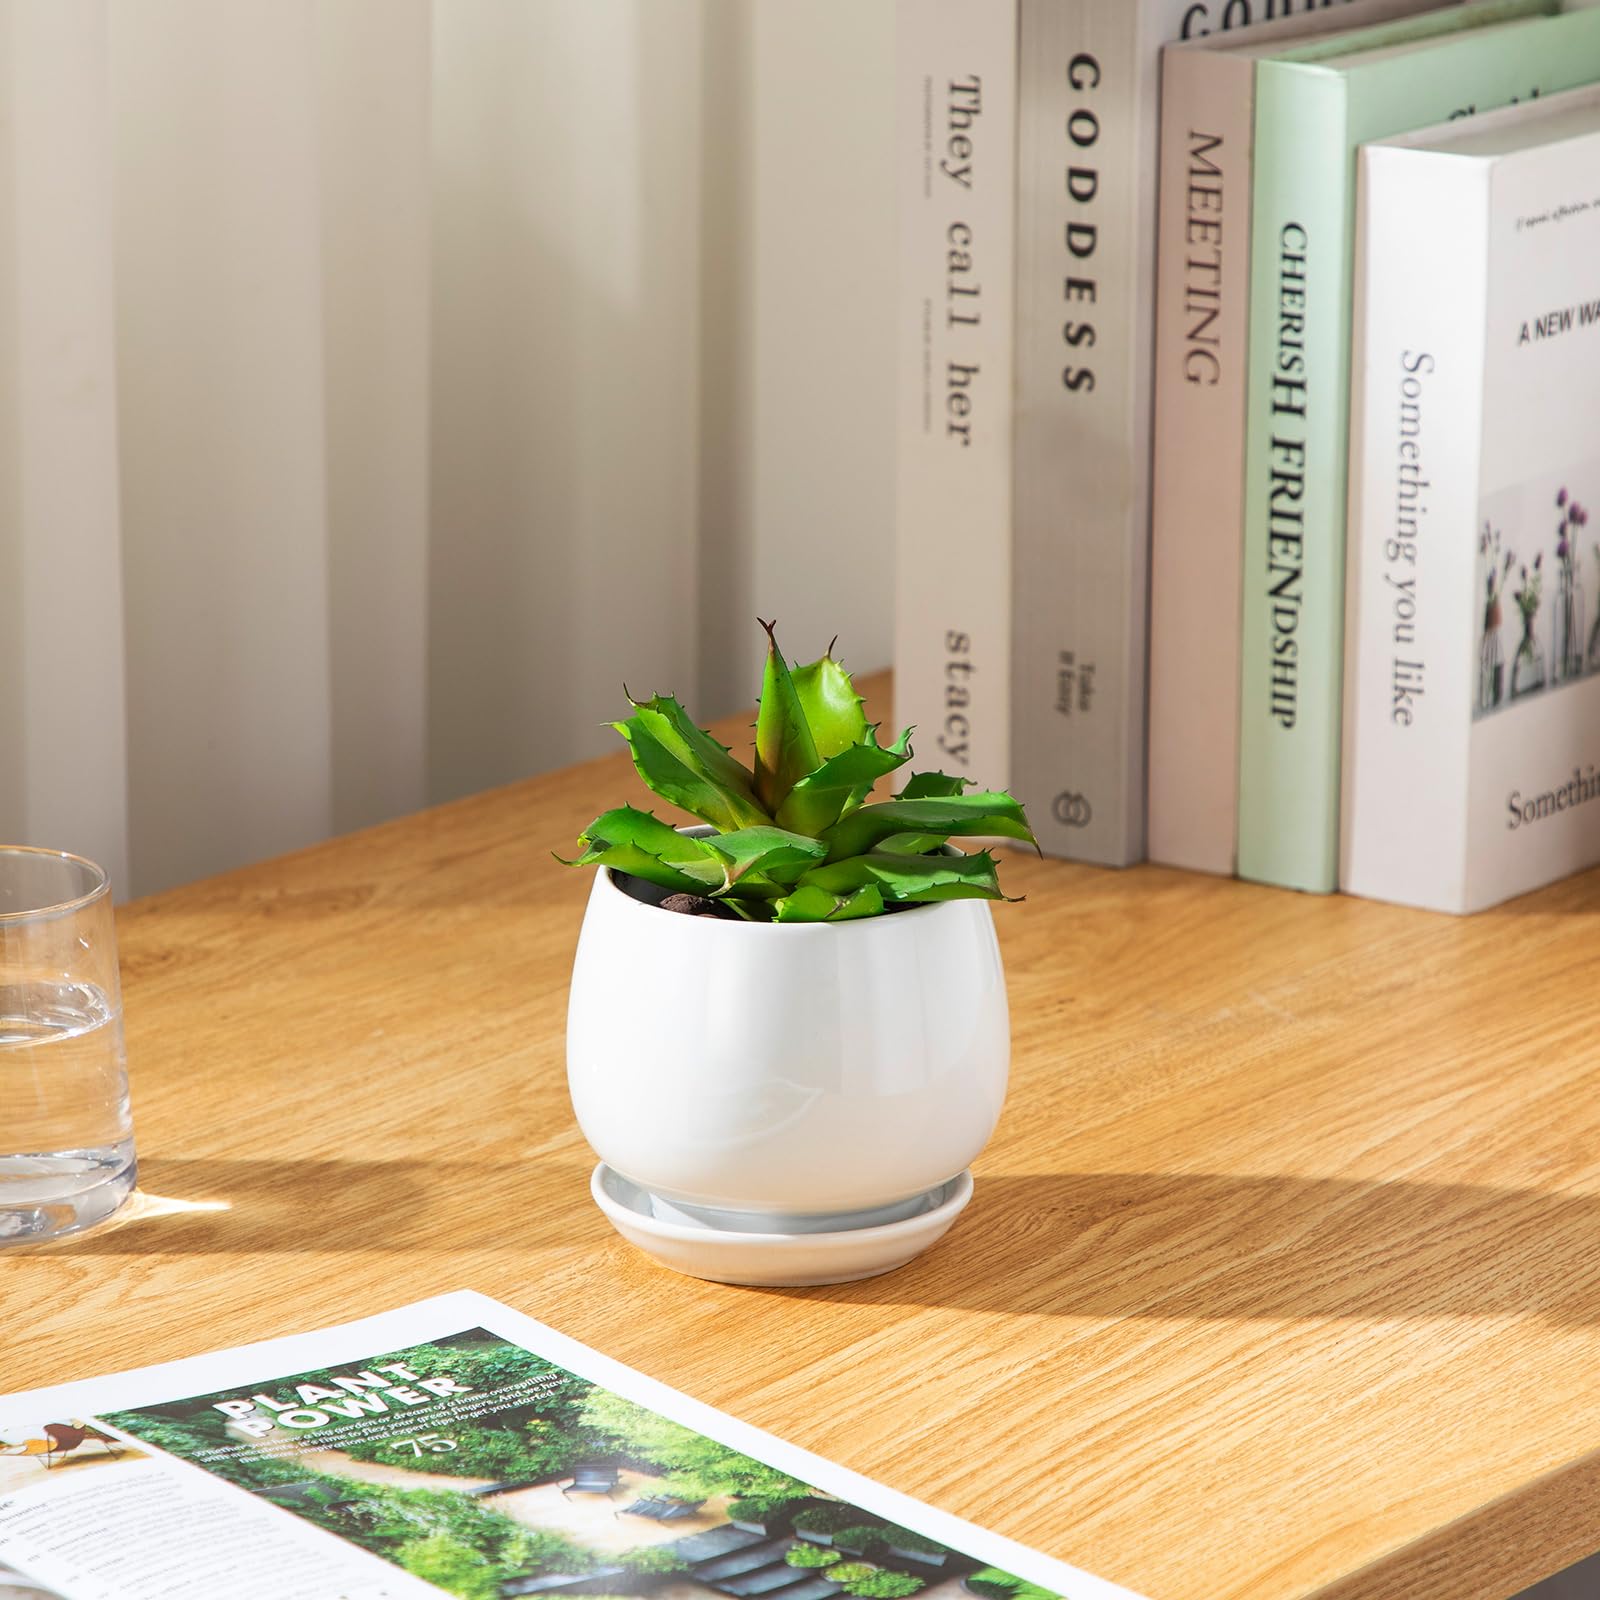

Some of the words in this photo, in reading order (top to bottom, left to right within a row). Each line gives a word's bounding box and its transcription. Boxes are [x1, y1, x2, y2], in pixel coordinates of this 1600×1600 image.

[940, 75, 981, 190] They
[1062, 53, 1101, 395] GODDESS
[1183, 129, 1224, 386] MEETING
[947, 222, 981, 329] call
[1271, 221, 1308, 419] CHERISH
[1517, 320, 1530, 347] A
[1535, 306, 1575, 341] NEW
[946, 363, 980, 447] her
[1385, 349, 1435, 566] Something
[1267, 434, 1306, 731] FRIENDSHIP
[1383, 573, 1418, 645] you
[937, 629, 978, 766] stacy
[1391, 658, 1426, 728] like
[1507, 764, 1600, 830] Somethi
[212, 1361, 420, 1421] PLANT
[228, 1377, 474, 1439] POWER
[299, 1438, 367, 1455] inspiration
[367, 1431, 391, 1441] and
[391, 1422, 432, 1436] expert
[431, 1417, 455, 1427] tips
[455, 1413, 469, 1421] to
[469, 1408, 490, 1419] get
[489, 1402, 513, 1414] you
[513, 1390, 555, 1406] started
[312, 1428, 334, 1438] big
[335, 1420, 379, 1435] garden
[378, 1416, 391, 1424] or
[393, 1407, 433, 1420] dream
[433, 1402, 447, 1411] of
[456, 1393, 489, 1405] home
[490, 1373, 558, 1396] overspilling
[319, 1433, 348, 1444] time
[362, 1425, 387, 1437] flex
[387, 1418, 414, 1431] your
[416, 1410, 452, 1423] green
[451, 1400, 498, 1416] fingers.
[499, 1390, 522, 1402] And
[523, 1385, 542, 1395] we
[542, 1378, 572, 1390] have
[391, 1432, 458, 1459] 75
